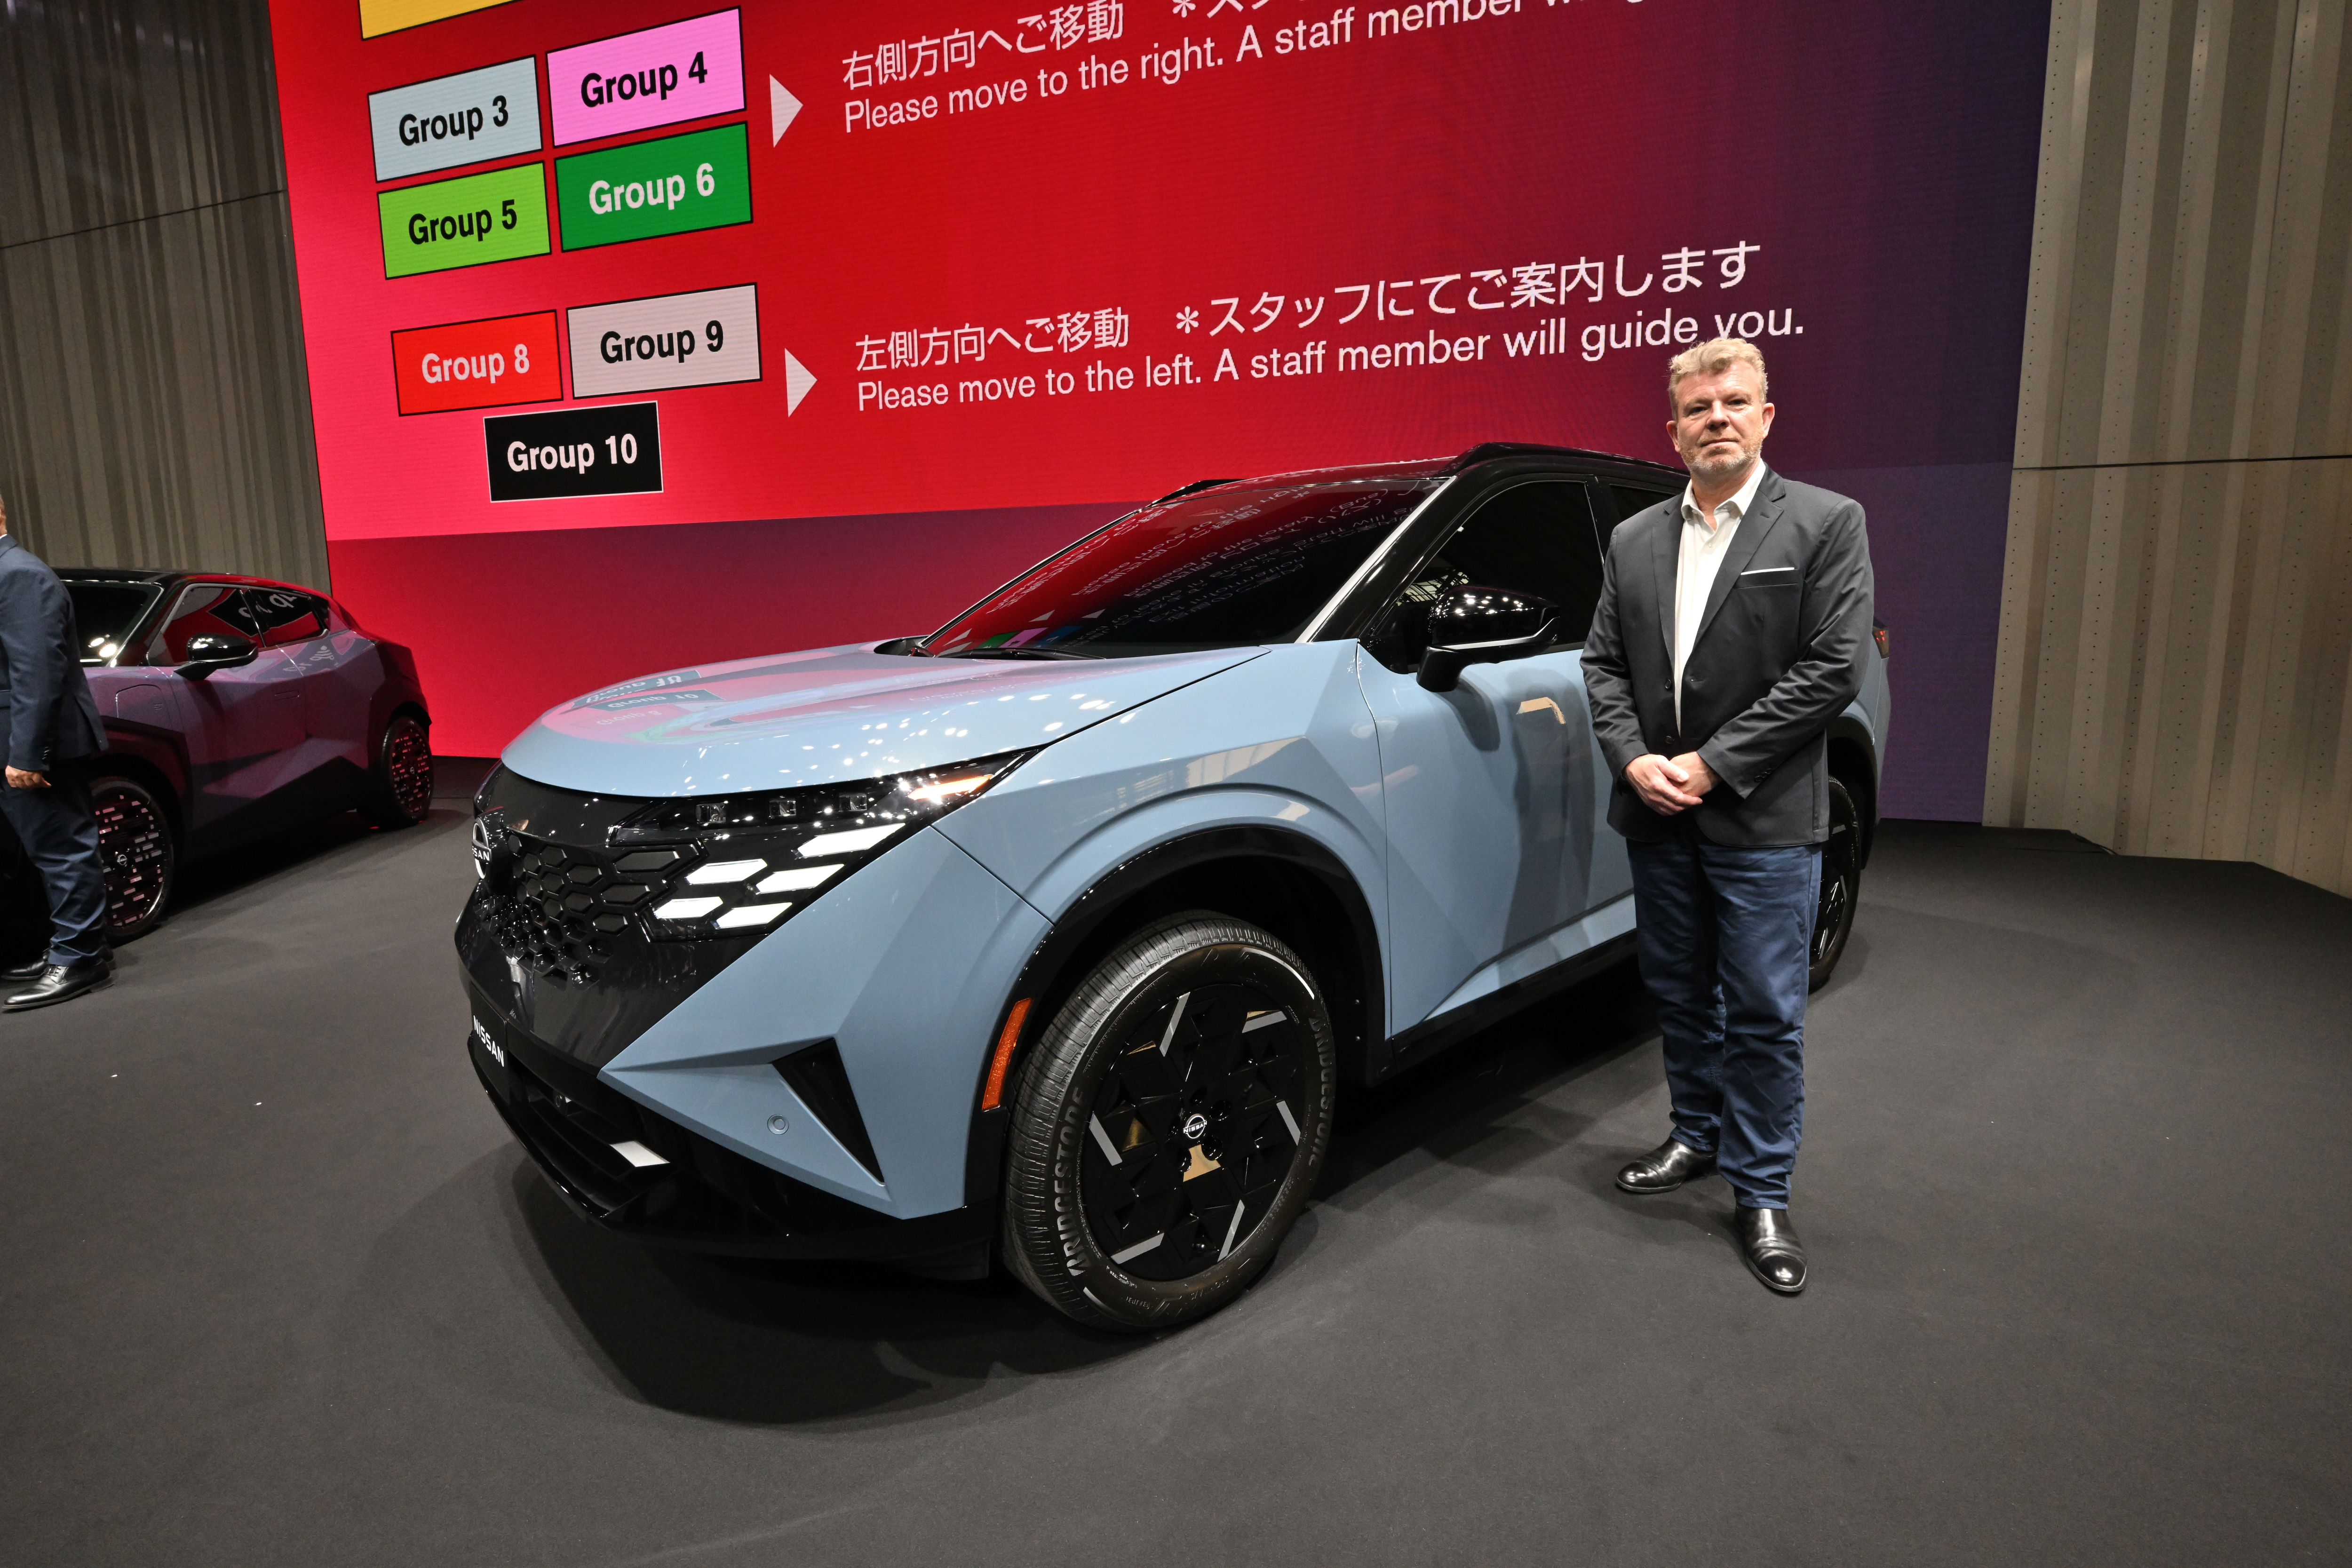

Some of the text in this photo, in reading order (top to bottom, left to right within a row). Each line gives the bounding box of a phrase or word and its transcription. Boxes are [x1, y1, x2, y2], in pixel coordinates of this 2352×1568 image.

[842, 0, 1123, 90] 右側方向へご移動
[845, 96, 938, 133] Please
[949, 79, 1027, 113] move
[1038, 69, 1067, 97] to
[1079, 55, 1128, 89] the
[1142, 37, 1223, 84] right.
[1236, 25, 1263, 62] A
[1275, 7, 1355, 54] staff
[581, 51, 707, 107] Group 4
[399, 96, 508, 146] Group 3
[589, 163, 715, 214] Group 6
[409, 199, 516, 244] Group 5
[422, 344, 529, 383] Group 8
[601, 320, 723, 363] Group 9
[856, 307, 1128, 371] 左側方向へご移動
[858, 308, 1803, 411] Please move to the left. A staff member will guide you.
[508, 434, 637, 474] Group 10
[473, 1015, 504, 1067] NISSAN
[1183, 1121, 1208, 1133] NISSAN
[1054, 1086, 1089, 1276] BRIDGESTONE
